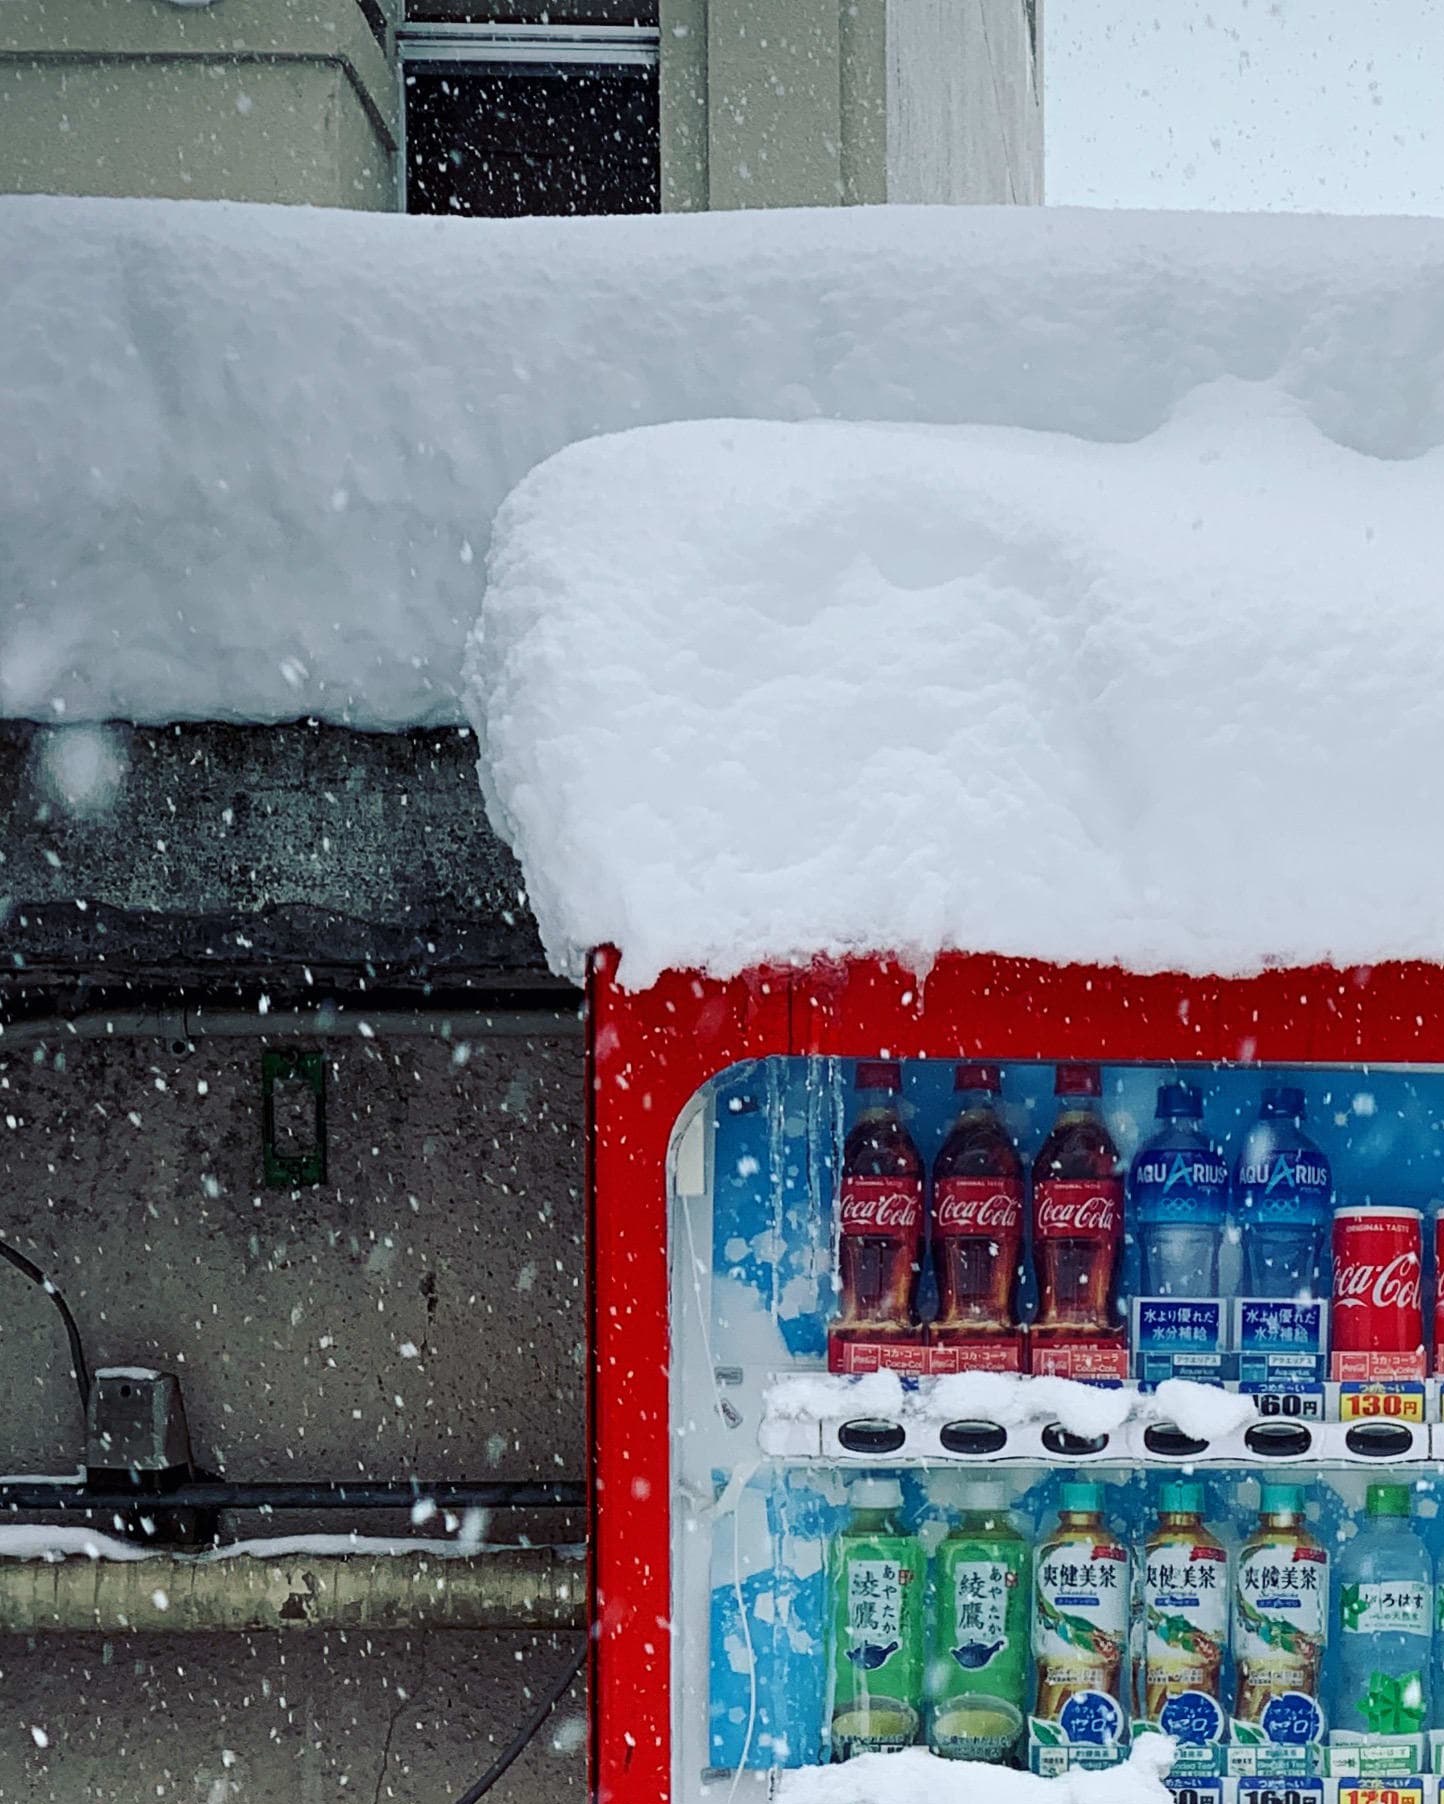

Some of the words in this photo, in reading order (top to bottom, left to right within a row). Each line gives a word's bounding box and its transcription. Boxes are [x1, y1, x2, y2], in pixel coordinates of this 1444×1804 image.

[1136, 1153, 1226, 1194] AQUARIUS
[1239, 1153, 1328, 1195] AQUARIUS
[841, 1193, 918, 1229] Coca-Cola
[938, 1193, 1017, 1229] Coca-Cola
[1038, 1196, 1114, 1231] Coca-Cola
[1346, 1394, 1418, 1417] 130円
[1043, 1563, 1118, 1589] 爽健美茶
[1244, 1565, 1319, 1590] 爽健美茶
[957, 1570, 988, 1632] 綾鷹
